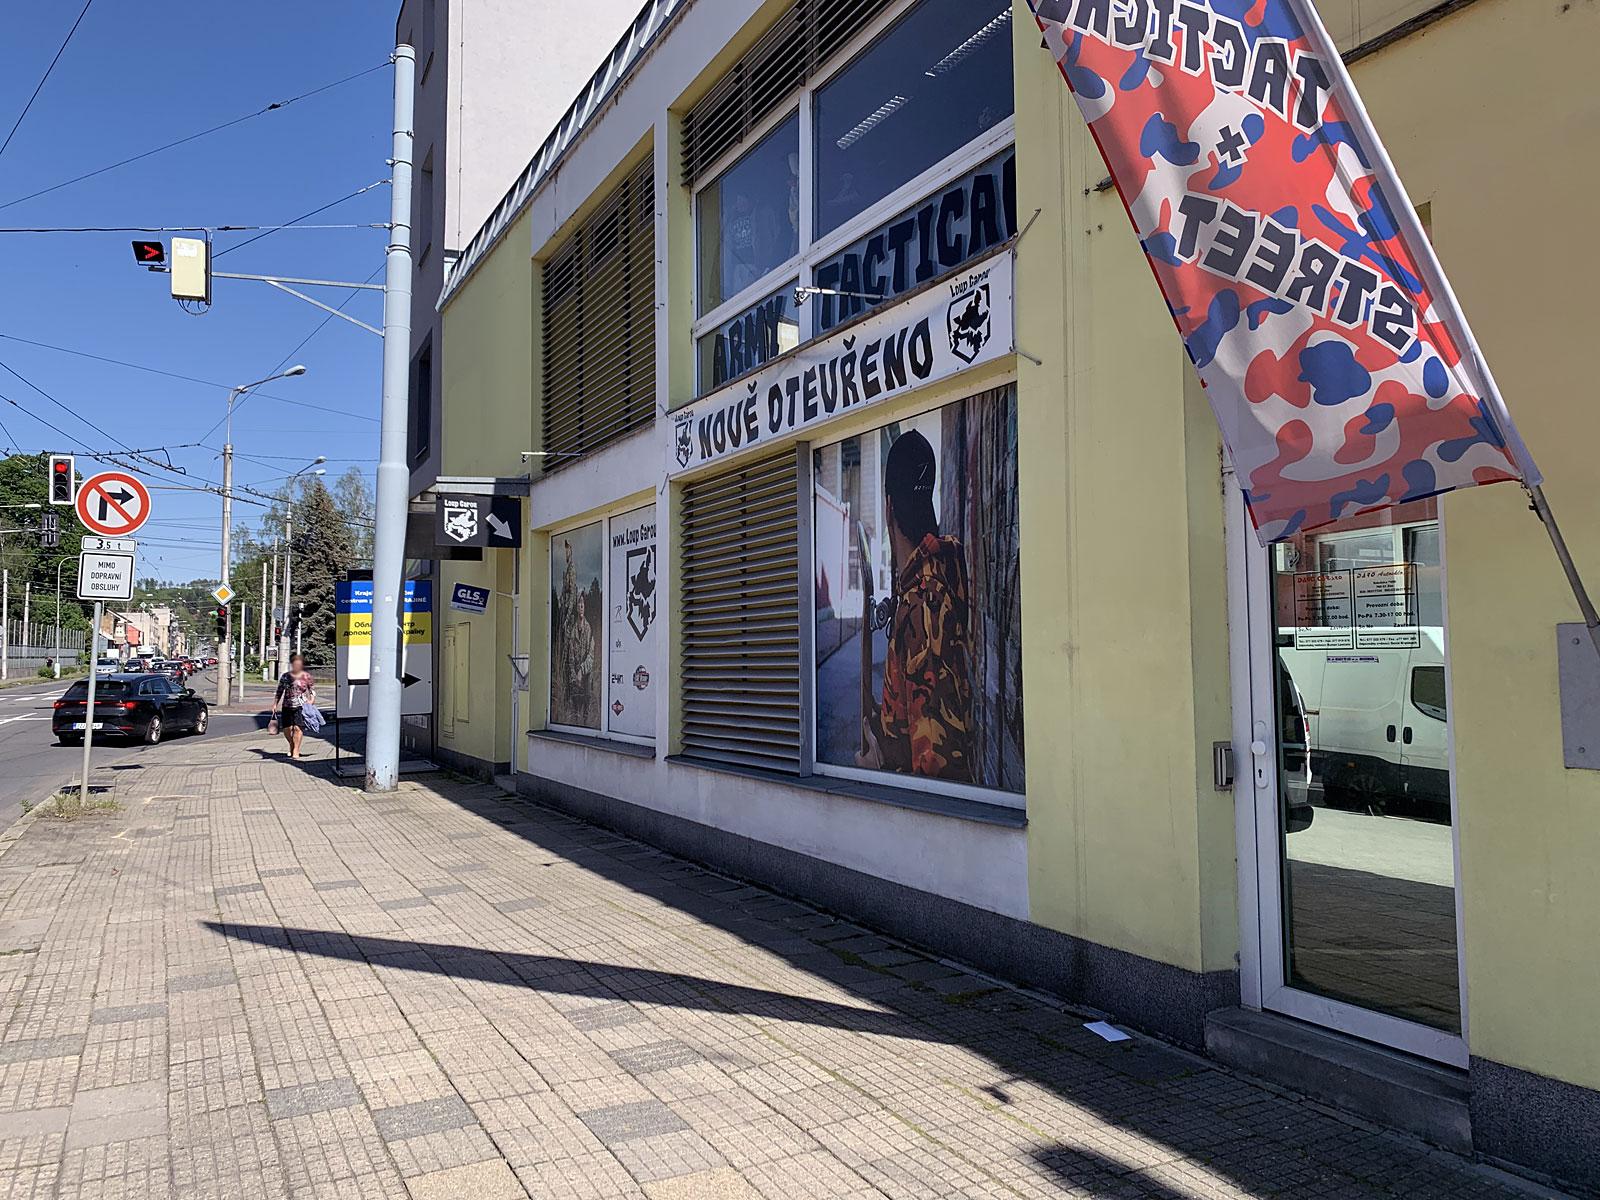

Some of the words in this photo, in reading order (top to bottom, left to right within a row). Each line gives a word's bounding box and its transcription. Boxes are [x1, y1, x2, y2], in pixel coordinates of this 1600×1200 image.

[950, 281, 968, 298] Loup
[712, 296, 788, 390] ARMY
[91, 571, 122, 580] DOPRAVNÍ
[91, 583, 120, 591] OBSLUHY
[457, 588, 481, 601] GLS
